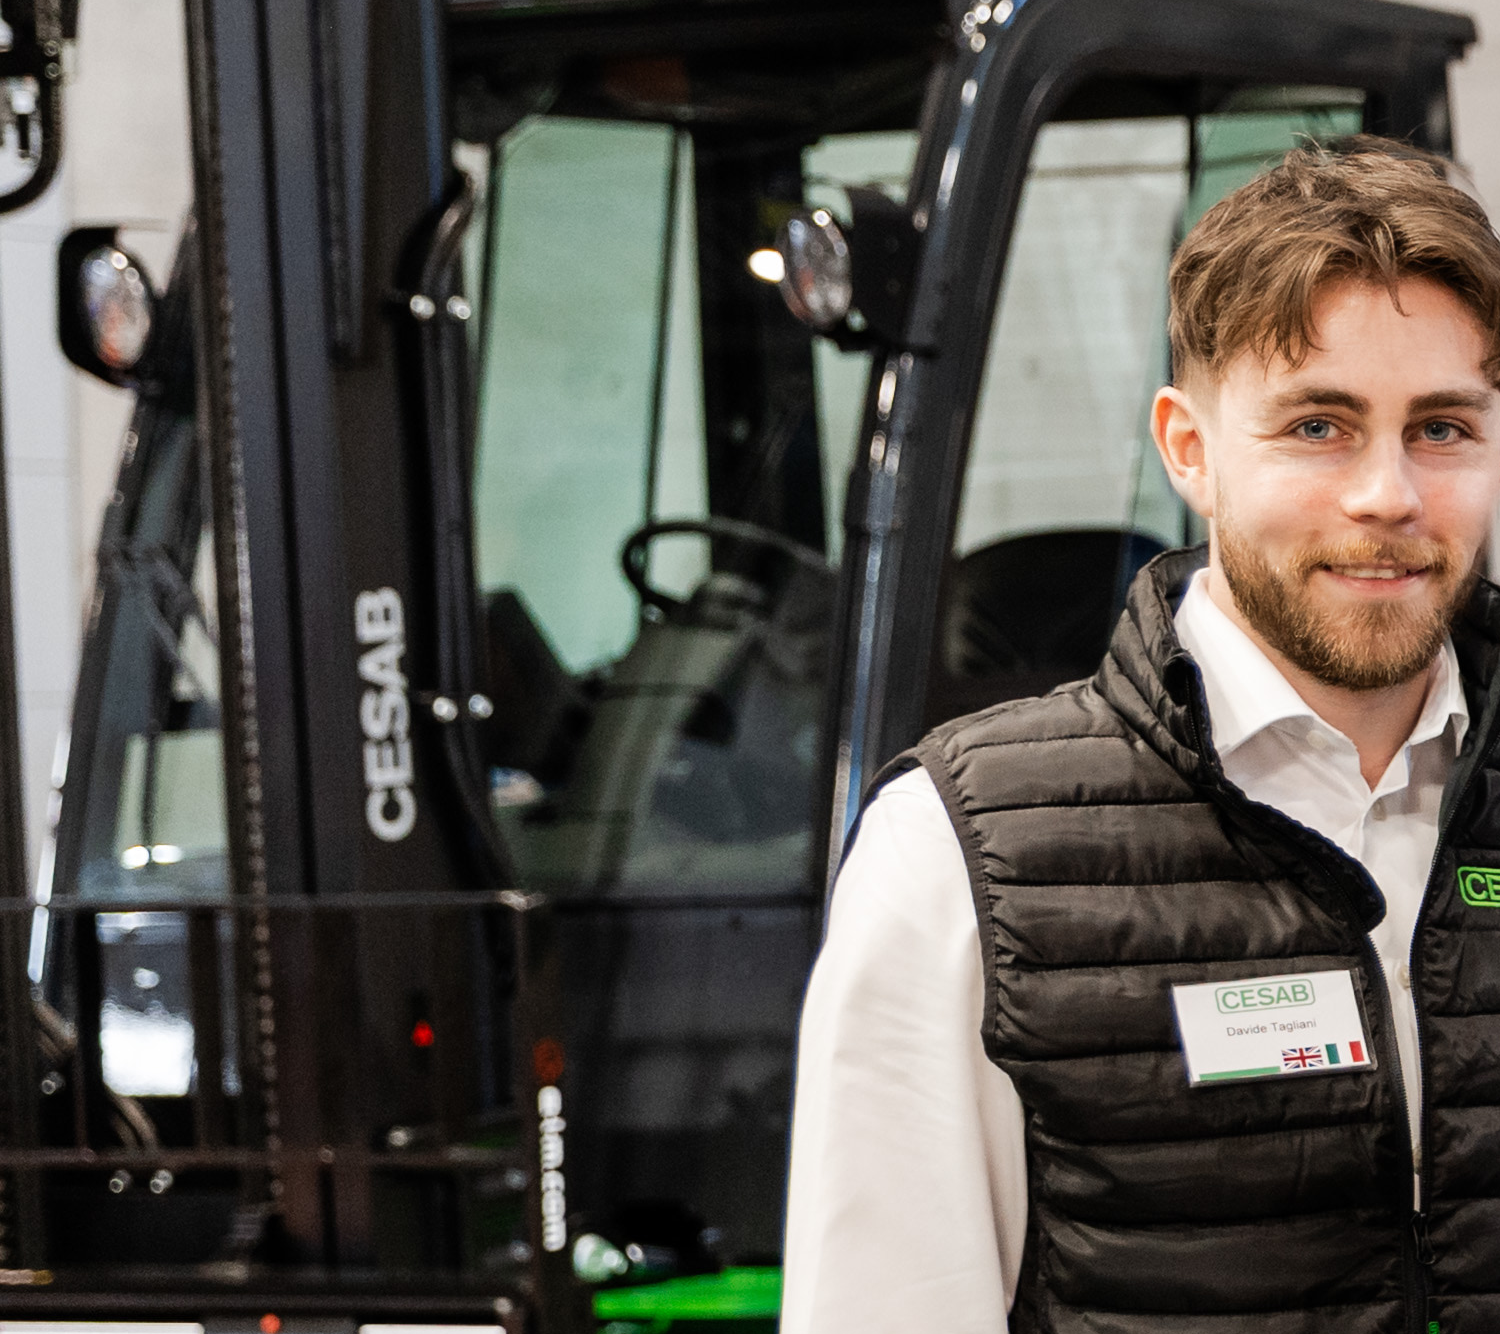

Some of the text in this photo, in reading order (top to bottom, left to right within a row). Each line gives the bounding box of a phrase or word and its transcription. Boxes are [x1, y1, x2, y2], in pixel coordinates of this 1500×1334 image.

[354, 587, 417, 842] CESAB
[1221, 984, 1309, 1010] CESAB
[1226, 1018, 1317, 1037] Davide Tagliani
